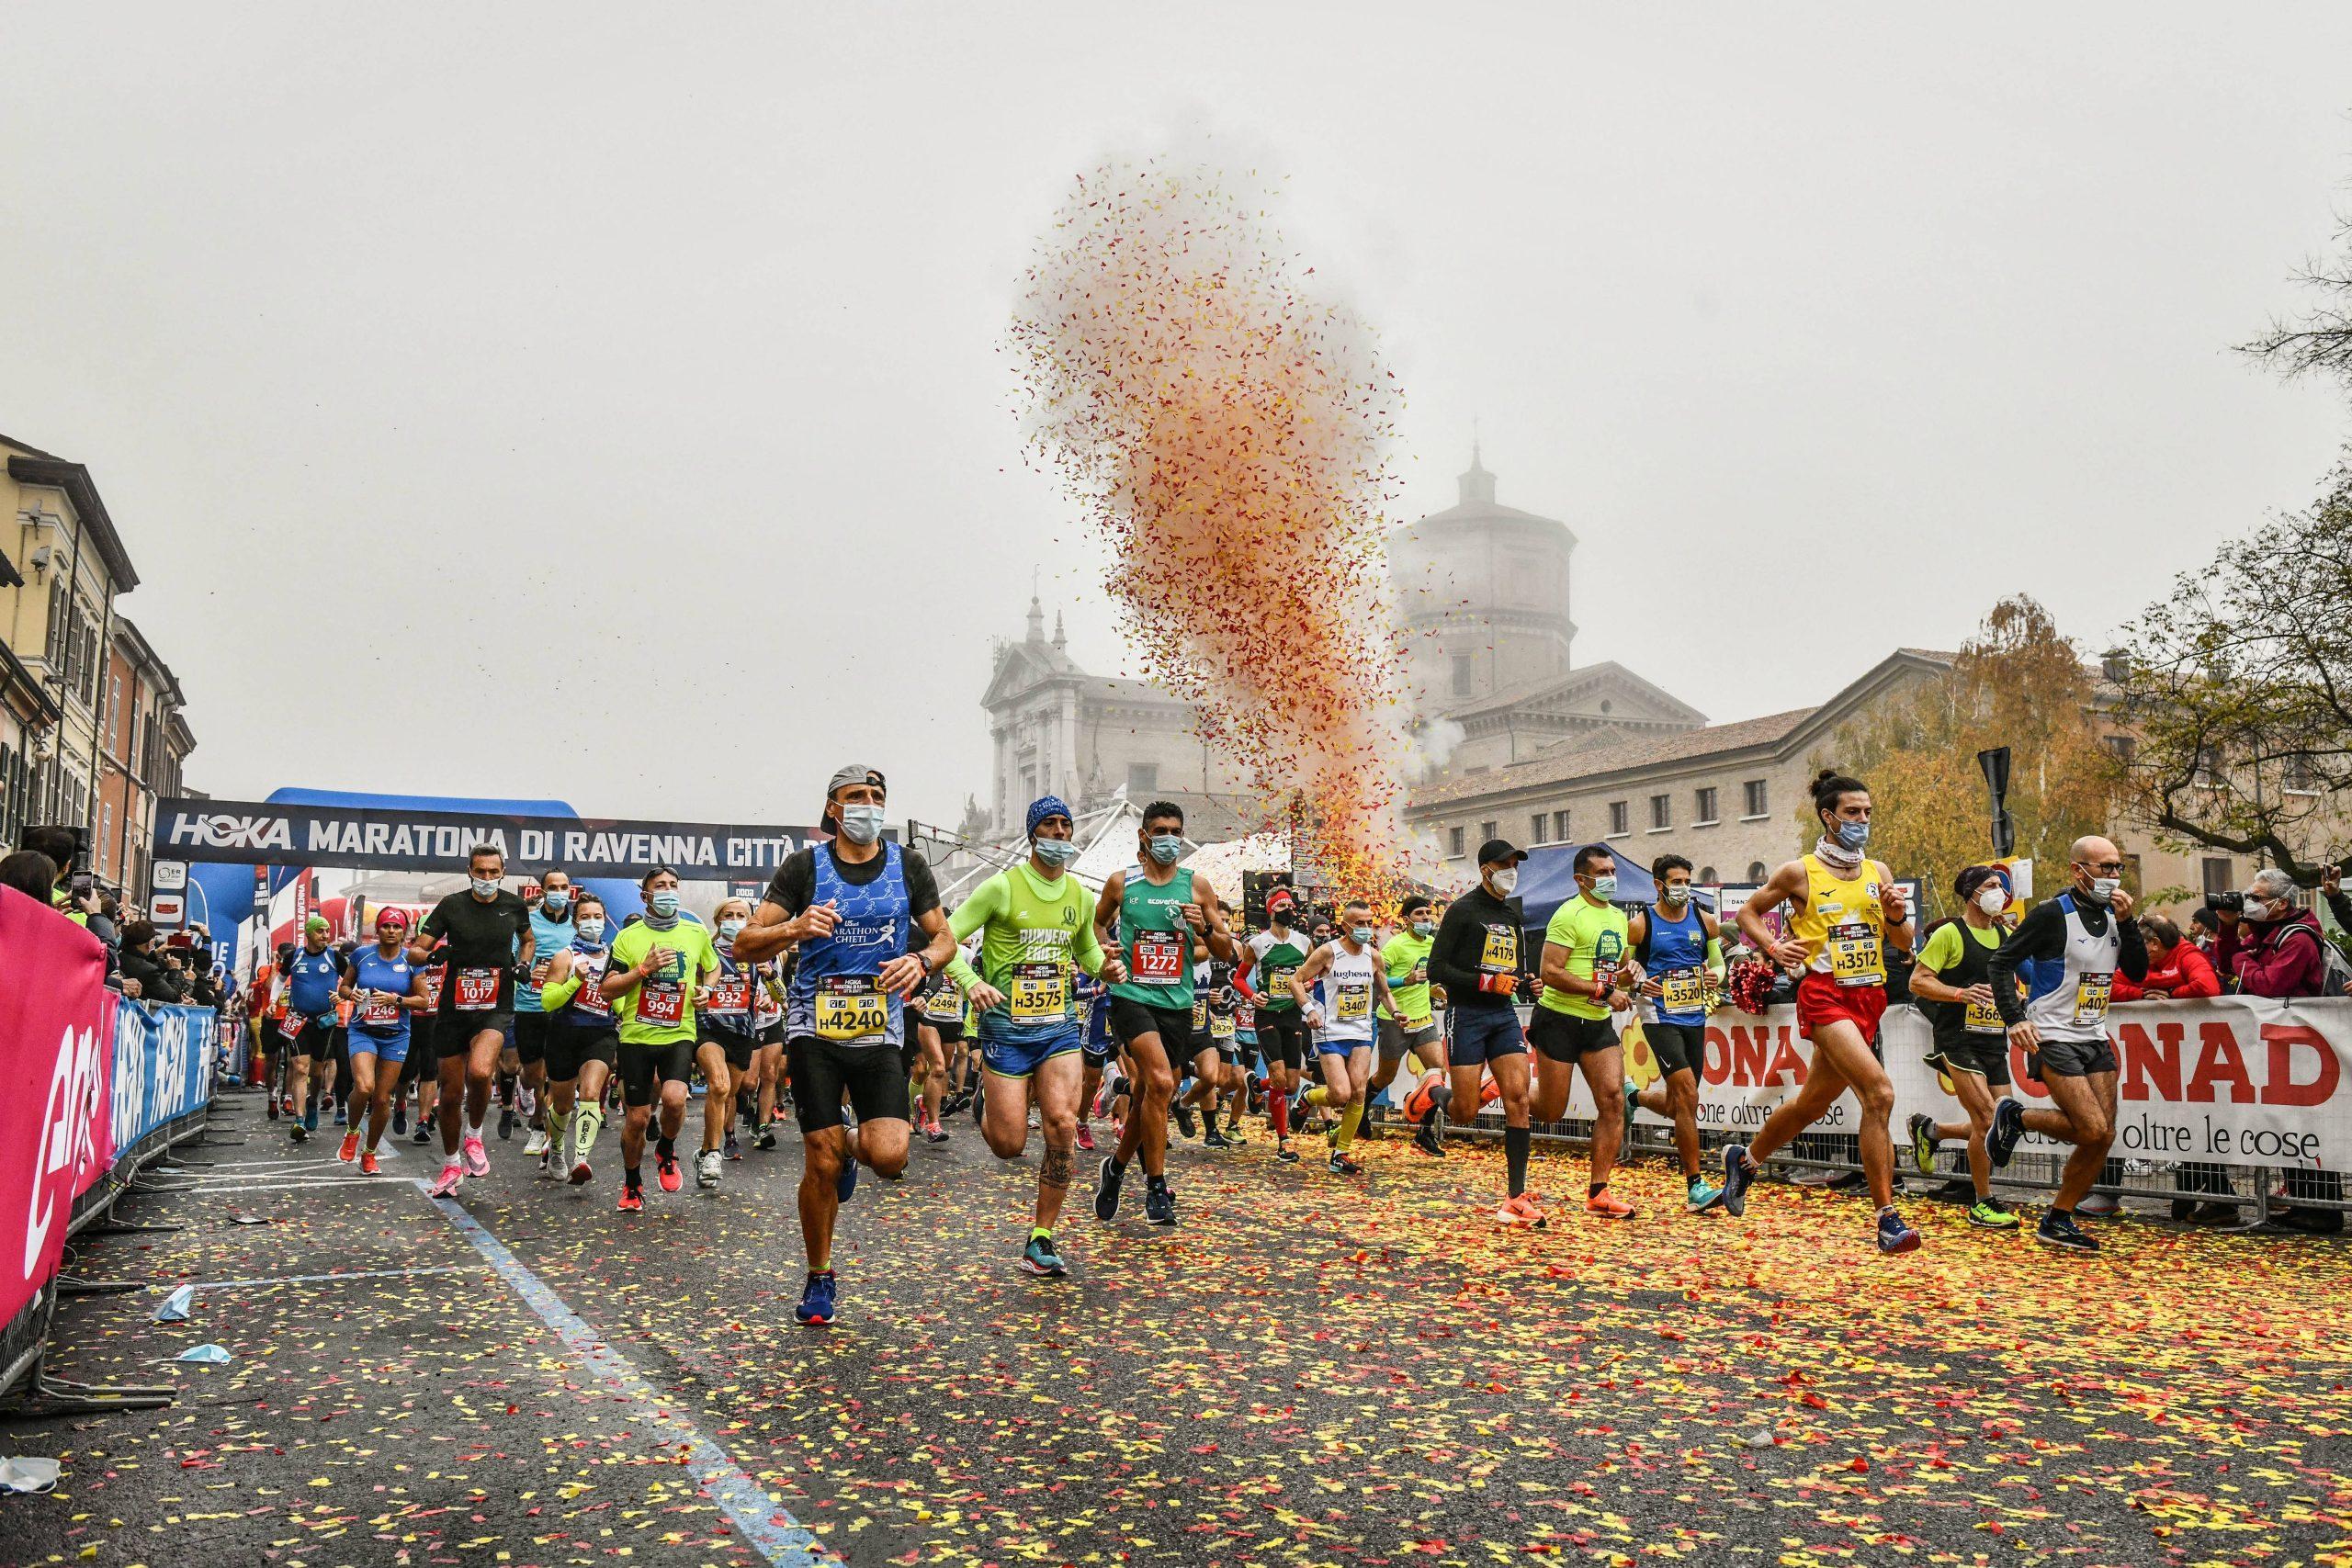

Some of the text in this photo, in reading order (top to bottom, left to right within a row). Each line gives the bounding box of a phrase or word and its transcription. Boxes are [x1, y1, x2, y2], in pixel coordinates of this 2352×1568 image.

[169, 812, 292, 851] HOKA
[308, 820, 509, 860] MARATONA
[519, 829, 554, 862] DI
[564, 831, 718, 866] RAVENNA
[833, 927, 879, 935] ARATHON
[1019, 929, 1072, 944] RUNNERS
[1178, 932, 1183, 941] B
[835, 935, 866, 943] CHIETI
[1486, 945, 1514, 961] H4179
[1837, 951, 1877, 970] H3512
[1140, 954, 1177, 970] 1272
[462, 987, 493, 999] 1017
[1272, 981, 1289, 990] H35
[717, 991, 741, 1003] 932
[1015, 990, 1061, 1008] H3575
[1666, 987, 1701, 1002] H3520
[368, 1005, 396, 1016] 1246
[647, 1000, 675, 1015] 994
[930, 998, 956, 1010] H2494
[1340, 1000, 1367, 1012] H3407
[283, 1021, 297, 1032] 815
[820, 1010, 885, 1030] H4240
[1702, 1026, 1808, 1087] ONA
[2009, 1022, 2340, 1107] CNAD
[1731, 1096, 1772, 1125] oltre
[2122, 1112, 2320, 1160] oltre le cose
